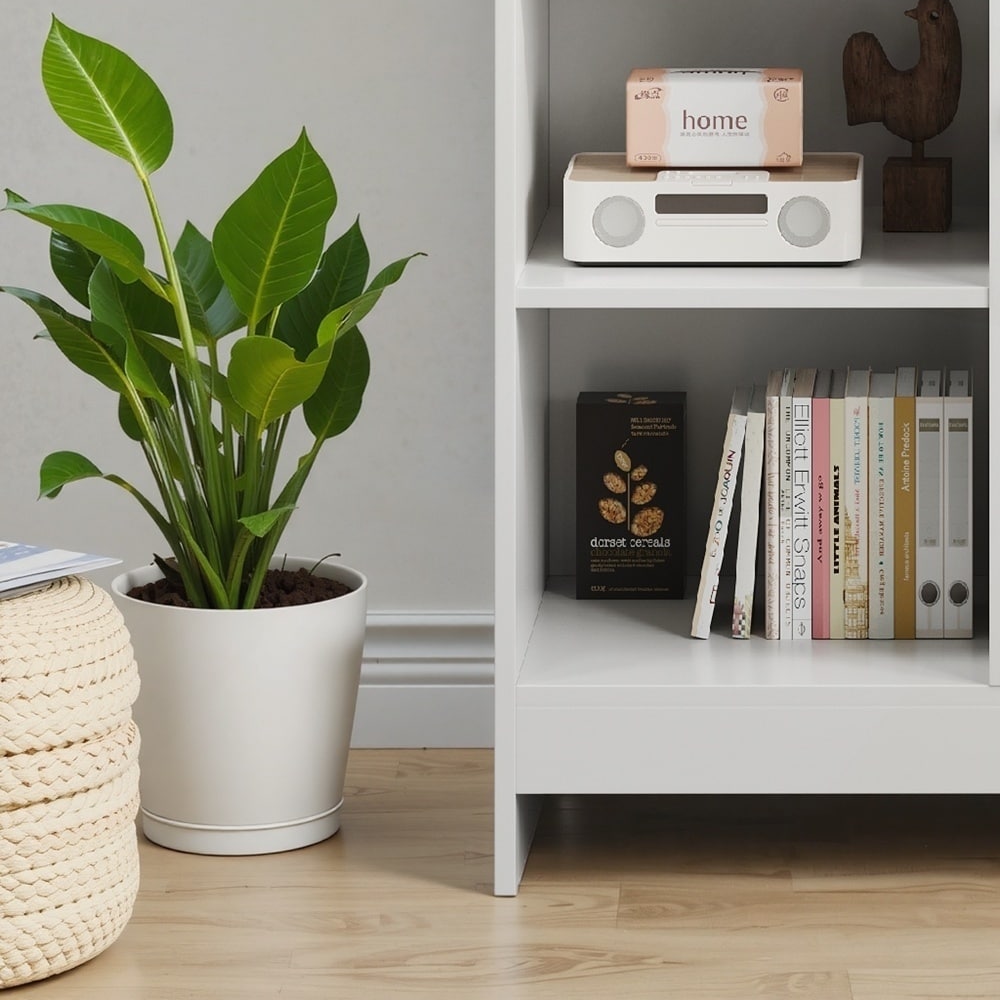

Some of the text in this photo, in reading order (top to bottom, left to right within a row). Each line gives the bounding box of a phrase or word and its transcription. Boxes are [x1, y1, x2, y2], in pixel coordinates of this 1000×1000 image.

[683, 109, 748, 130] home
[720, 449, 737, 505] JOAQUIN
[901, 422, 910, 492] Antoine Predock
[792, 404, 811, 610] Elliott Erwitt Snaps
[590, 536, 671, 548] dorset cereals
